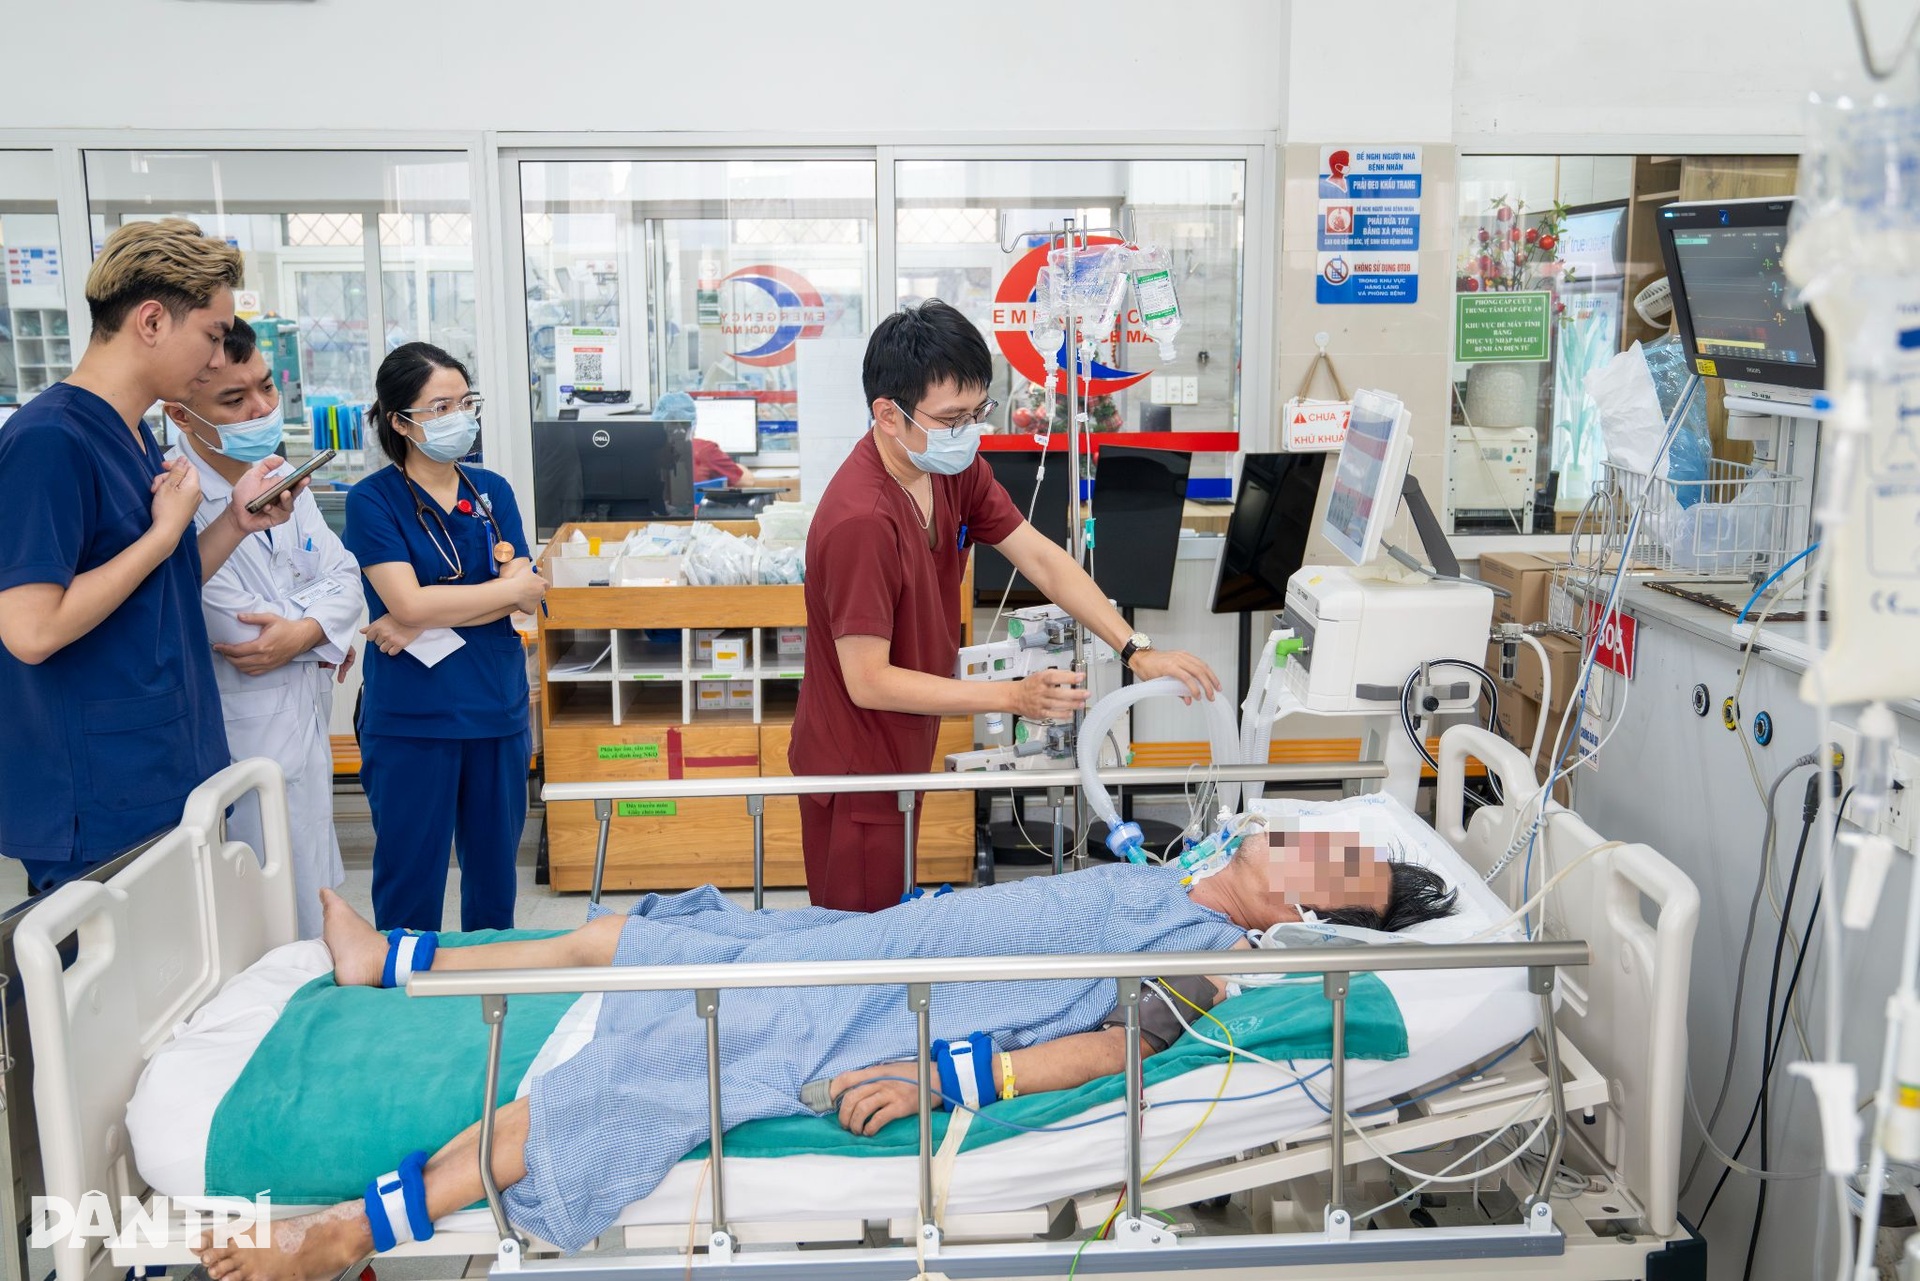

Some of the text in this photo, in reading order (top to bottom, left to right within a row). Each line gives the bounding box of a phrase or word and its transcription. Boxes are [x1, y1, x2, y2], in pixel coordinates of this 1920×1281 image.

[1366, 153, 1381, 161] NGHỊ
[1382, 151, 1402, 160] NGƯỜI
[1403, 152, 1416, 160] NHÀ
[1368, 162, 1404, 172] BỆNH NHÂN
[1353, 176, 1367, 190] PHẢI
[1396, 180, 1416, 190] TRANG
[1367, 215, 1383, 225] PHẢI
[1398, 217, 1410, 225] TAY
[1354, 262, 1373, 272] KHÔNG
[1475, 298, 1498, 306] PHÒNG
[1507, 320, 1523, 328] MÁY
[1308, 411, 1337, 422] CHƯA
